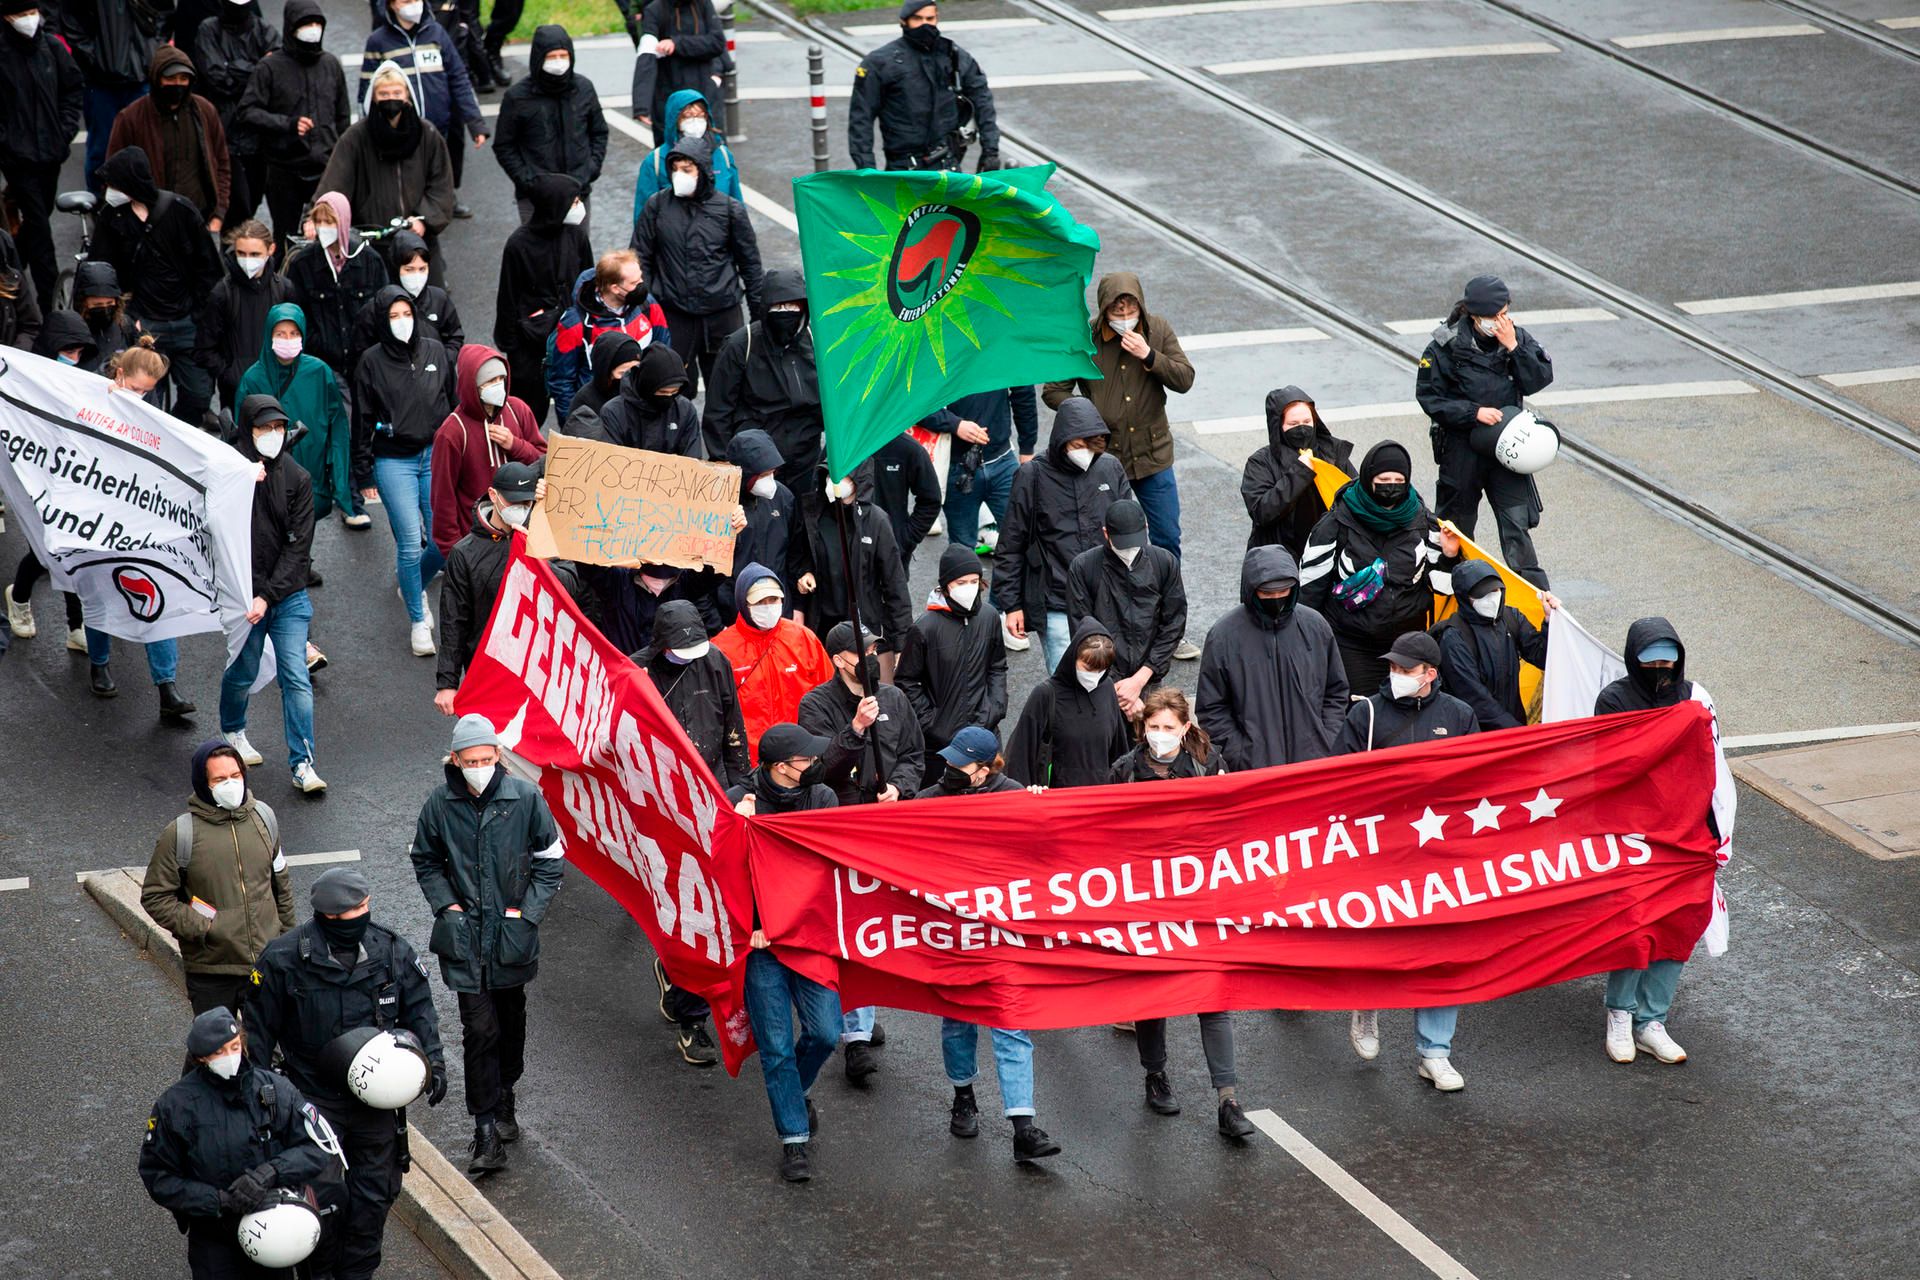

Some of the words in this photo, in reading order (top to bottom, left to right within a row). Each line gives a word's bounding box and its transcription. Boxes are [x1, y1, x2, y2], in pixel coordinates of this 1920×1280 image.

[907, 204, 949, 228] ANTIFA
[76, 407, 117, 431] ANTIFA
[130, 426, 161, 450] COLOGNE
[544, 482, 587, 519] DER
[41, 504, 103, 541] und
[1048, 814, 1385, 915] SOLIDARITÄT
[855, 914, 1026, 958] GEGEN
